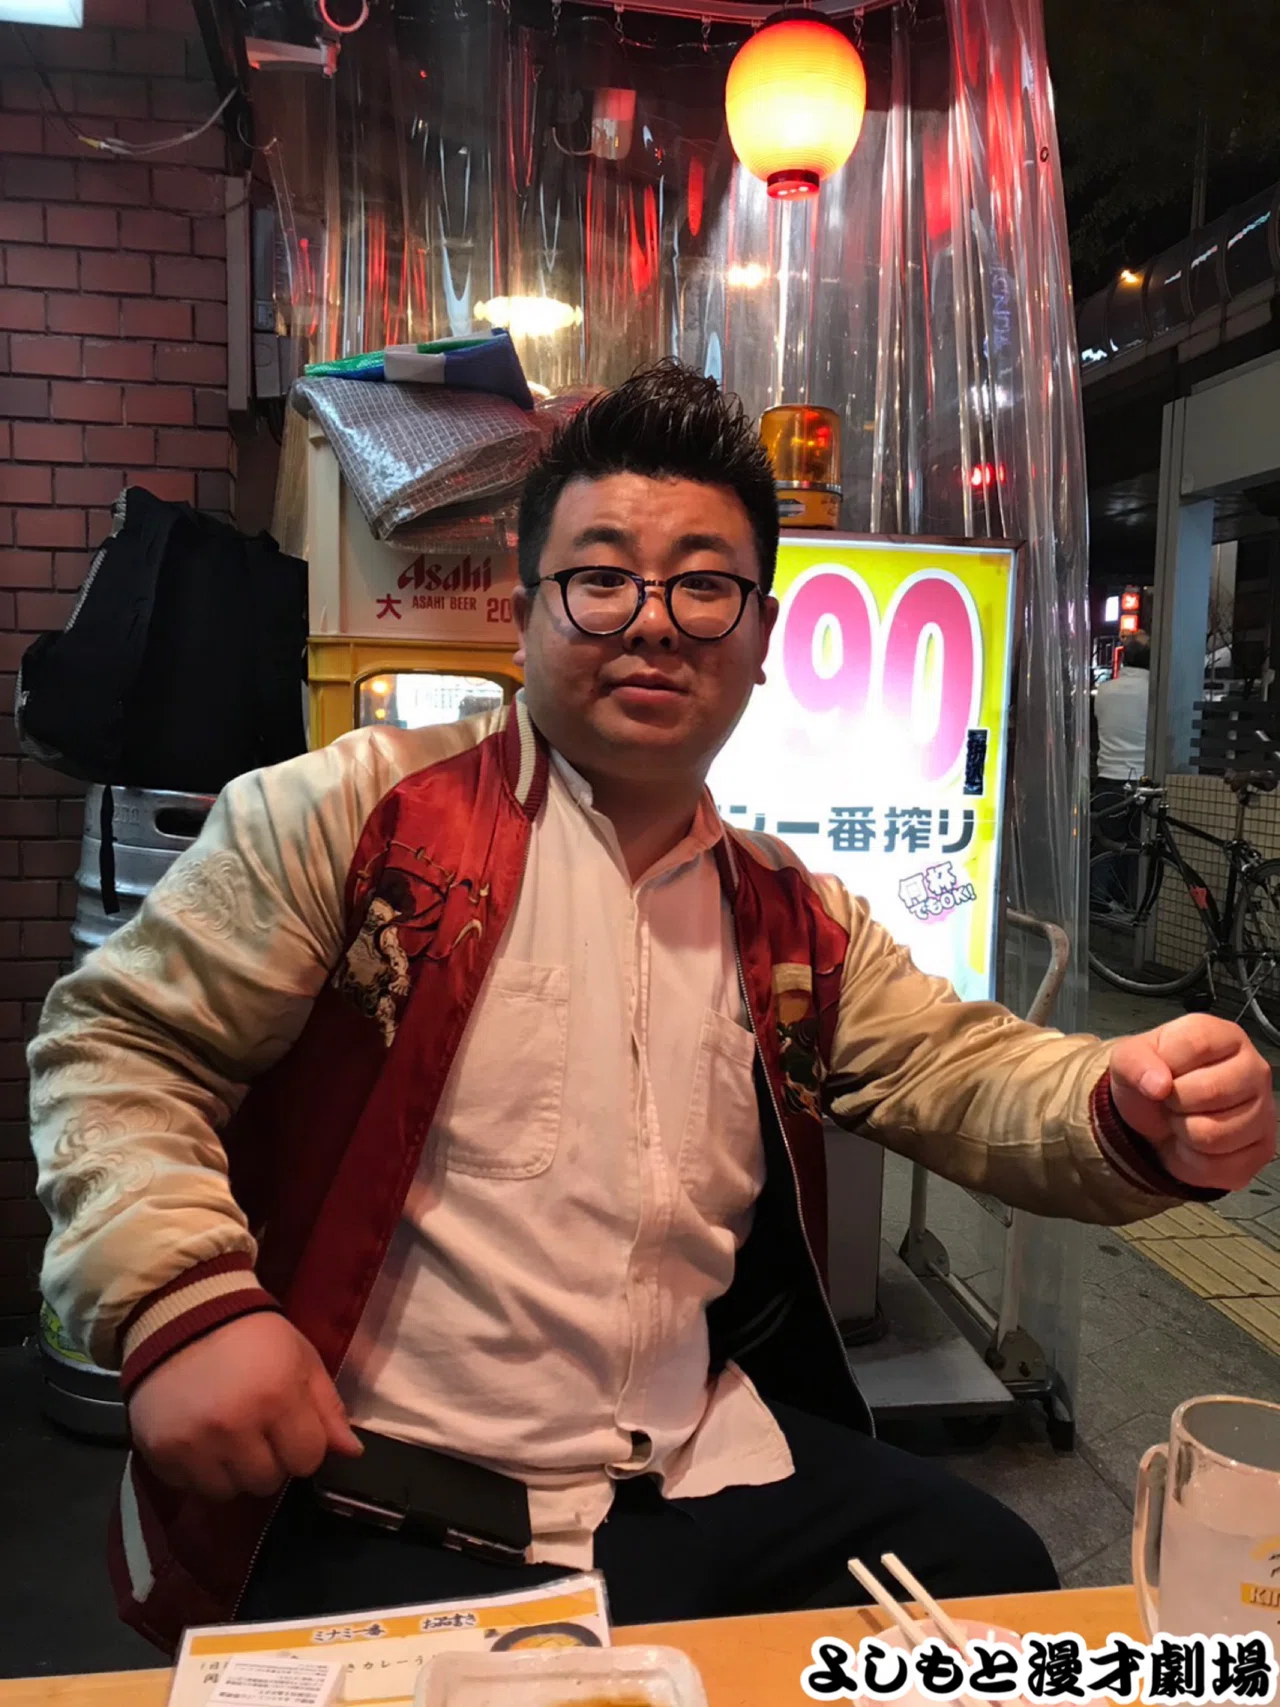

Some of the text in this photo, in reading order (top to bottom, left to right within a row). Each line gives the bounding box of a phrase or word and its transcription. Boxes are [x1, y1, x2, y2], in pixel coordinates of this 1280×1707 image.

[397, 554, 491, 592] Asahi
[376, 594, 402, 620] 大
[412, 596, 477, 611] ASAHI BEER
[717, 805, 975, 853] ン一番搾り
